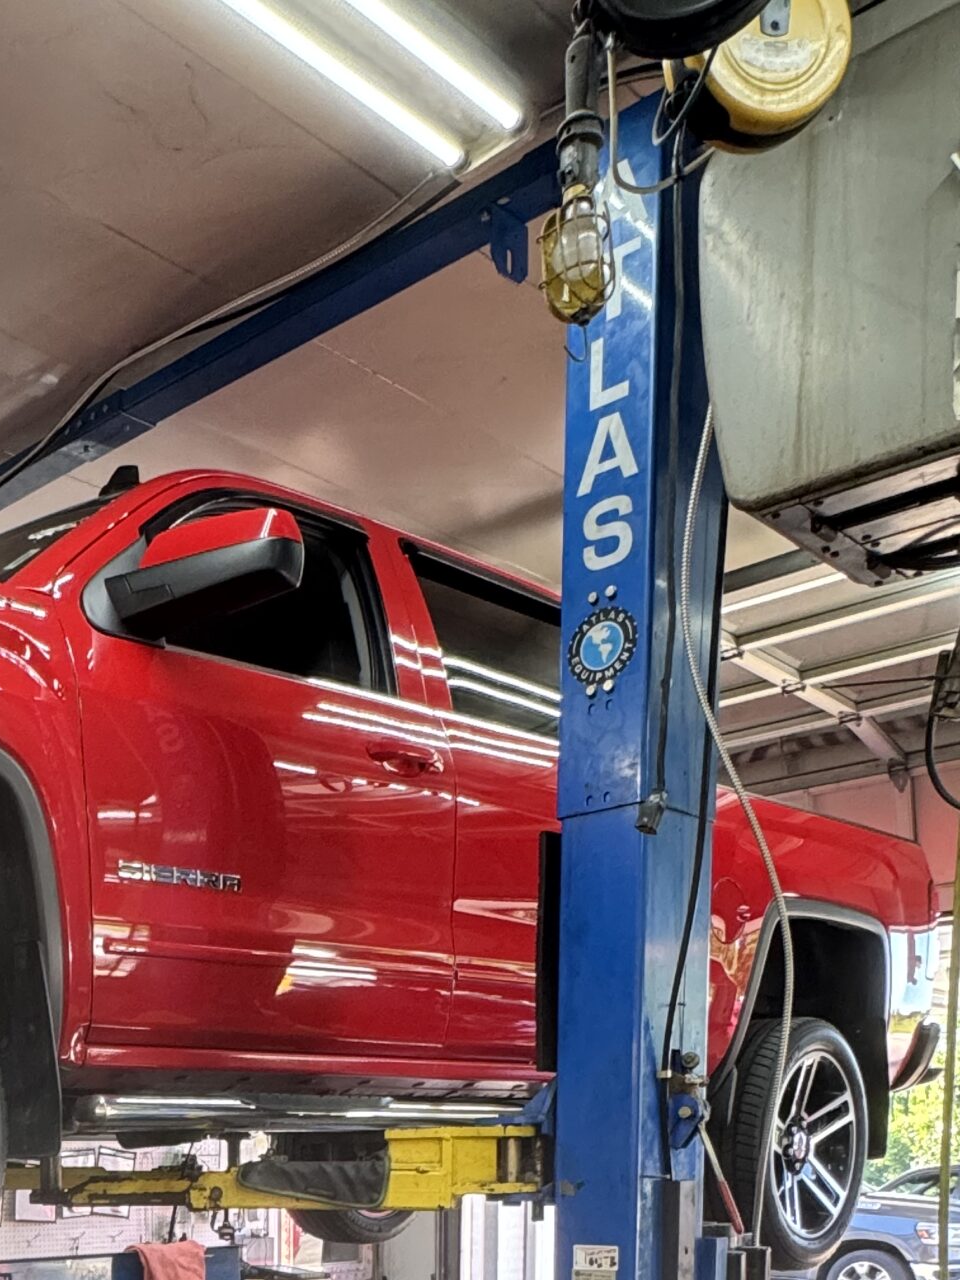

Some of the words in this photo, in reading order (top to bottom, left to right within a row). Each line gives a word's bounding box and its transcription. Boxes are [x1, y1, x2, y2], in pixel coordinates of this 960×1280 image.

[582, 610, 626, 633] ATLAS
[571, 641, 634, 682] EQUIPMENT
[117, 859, 242, 893] SIERRA
